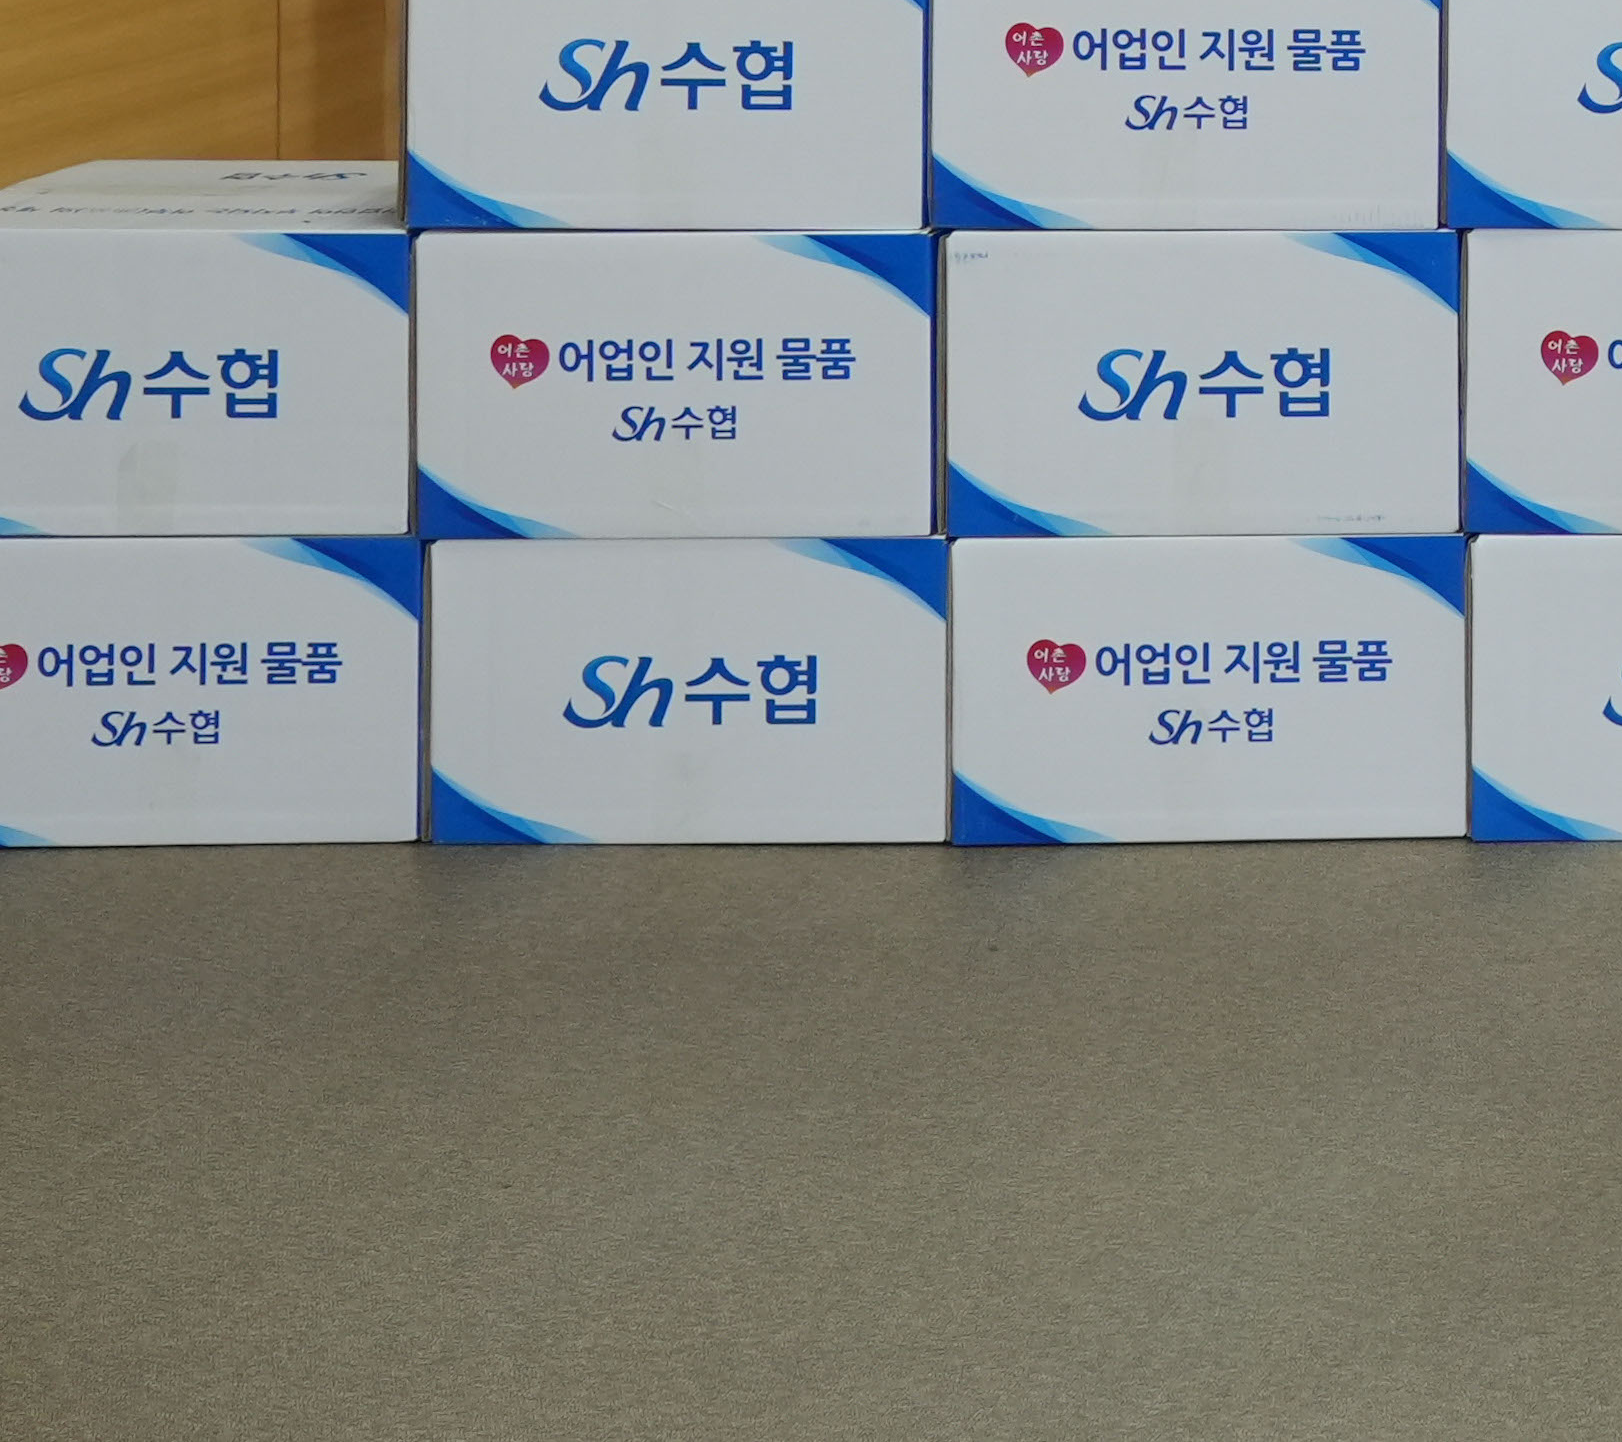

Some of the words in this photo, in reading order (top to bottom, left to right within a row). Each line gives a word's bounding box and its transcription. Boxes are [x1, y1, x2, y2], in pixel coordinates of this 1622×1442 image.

[1074, 29, 1187, 71] 어업인
[1200, 29, 1276, 71] 지원
[1288, 29, 1366, 72] 물품
[540, 38, 796, 112] Sh수협
[1126, 95, 1248, 131] Sh수협
[560, 339, 675, 381] 어업인
[689, 338, 765, 381] 지원
[777, 338, 856, 380] 물품
[20, 347, 280, 421] Sh수협
[1078, 347, 1332, 422] Sh수협
[614, 405, 738, 441] Sh수협
[40, 644, 156, 686] 어업인
[171, 642, 249, 685] 지원
[264, 641, 343, 685] 물품
[1097, 642, 1211, 686] 어업인
[1225, 641, 1302, 684] 지원
[1315, 639, 1392, 683] 물품
[564, 654, 820, 728] Sh수협
[93, 710, 221, 747] Sh수협
[1150, 709, 1275, 746] Sh수협
